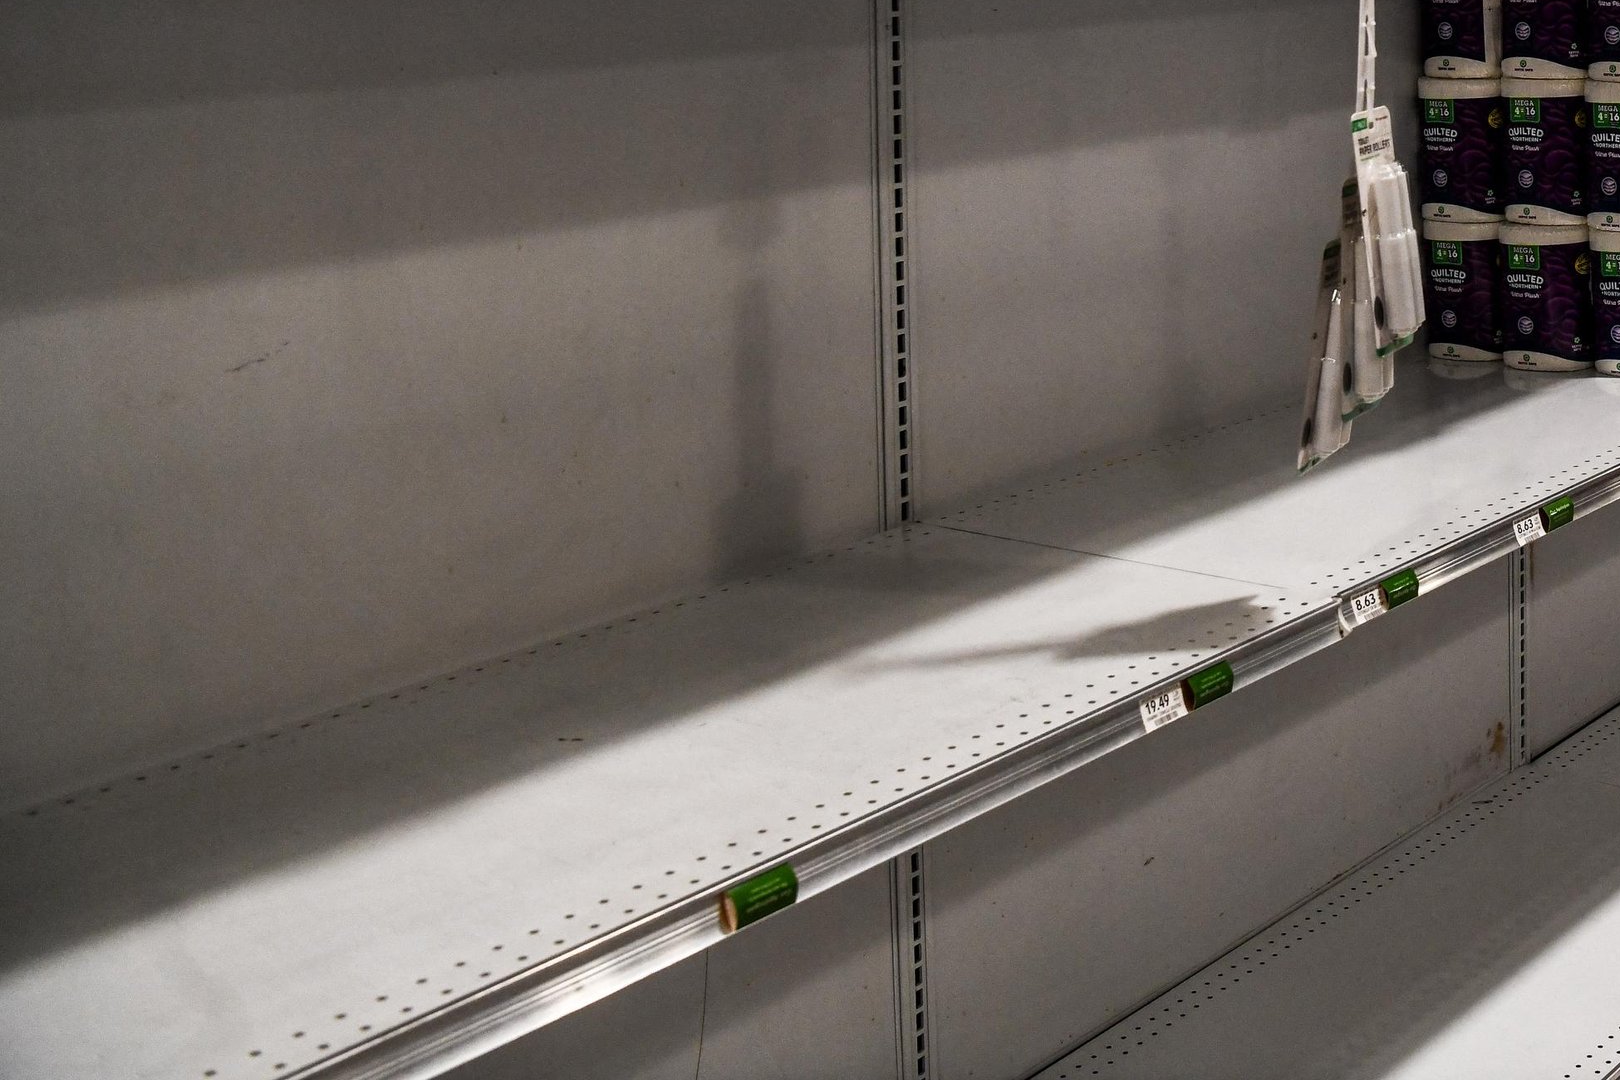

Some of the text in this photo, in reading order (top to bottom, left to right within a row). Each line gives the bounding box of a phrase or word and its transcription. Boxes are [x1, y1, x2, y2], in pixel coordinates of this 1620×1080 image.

[1423, 127, 1458, 138] QUILTED
[1508, 126, 1544, 137] QUILTED
[1431, 269, 1467, 279] QUILTED
[1506, 274, 1544, 285] QUILTED
[1517, 519, 1533, 534] 8.63
[1355, 593, 1376, 611] 8.63
[1145, 694, 1169, 715] 19.49
